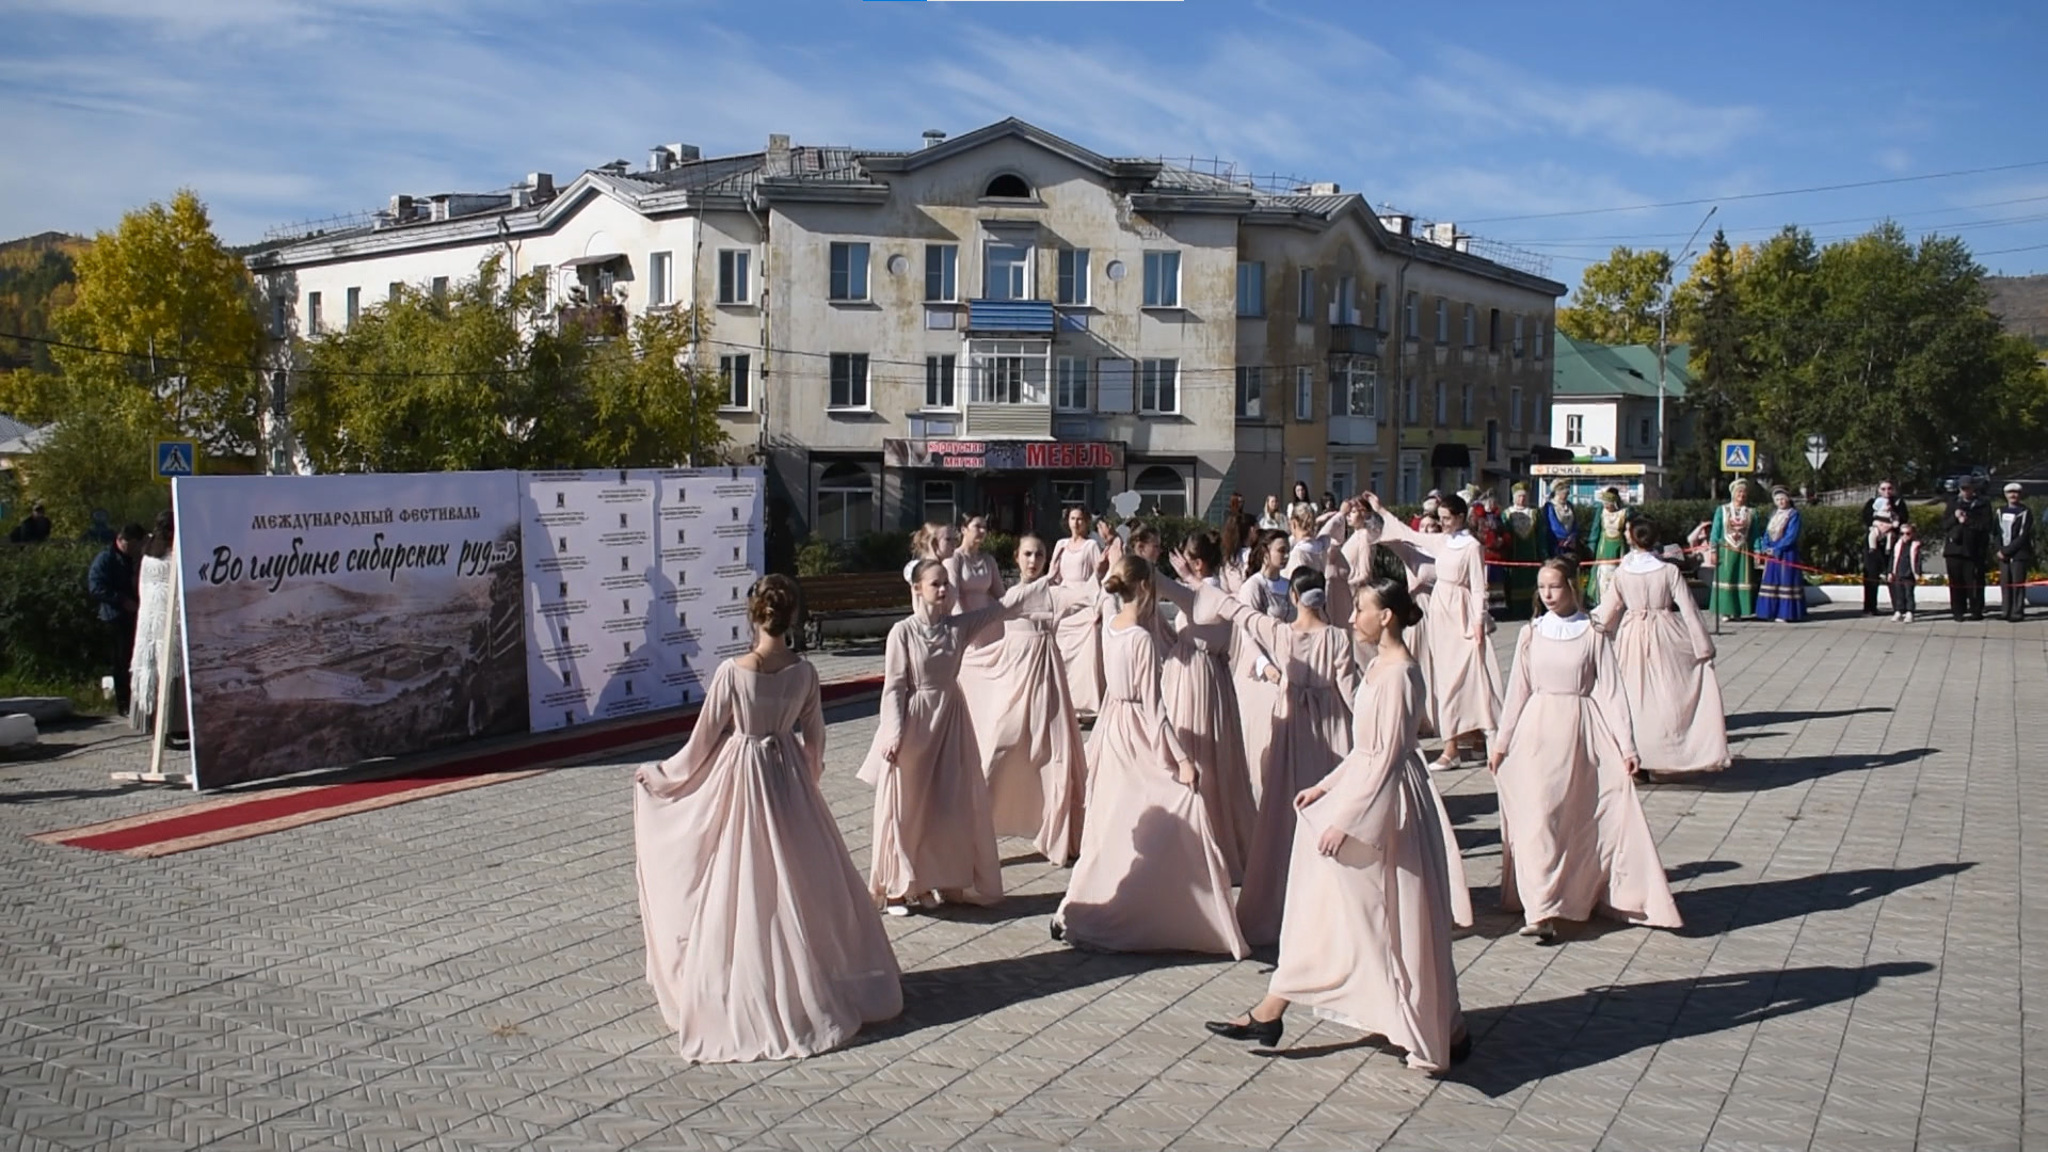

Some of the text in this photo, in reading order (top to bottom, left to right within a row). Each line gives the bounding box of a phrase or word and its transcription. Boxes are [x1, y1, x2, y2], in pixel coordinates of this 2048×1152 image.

[1026, 443, 1114, 468] МЕБЕЛЬ
[1546, 466, 1582, 474] ТОЧКА
[251, 506, 481, 531] МЕЖДУНАРОДНЫЙ ФЕСТИВАЛЬ
[198, 545, 243, 585] «Во
[249, 536, 341, 593] глубине
[346, 532, 450, 582] сибирских
